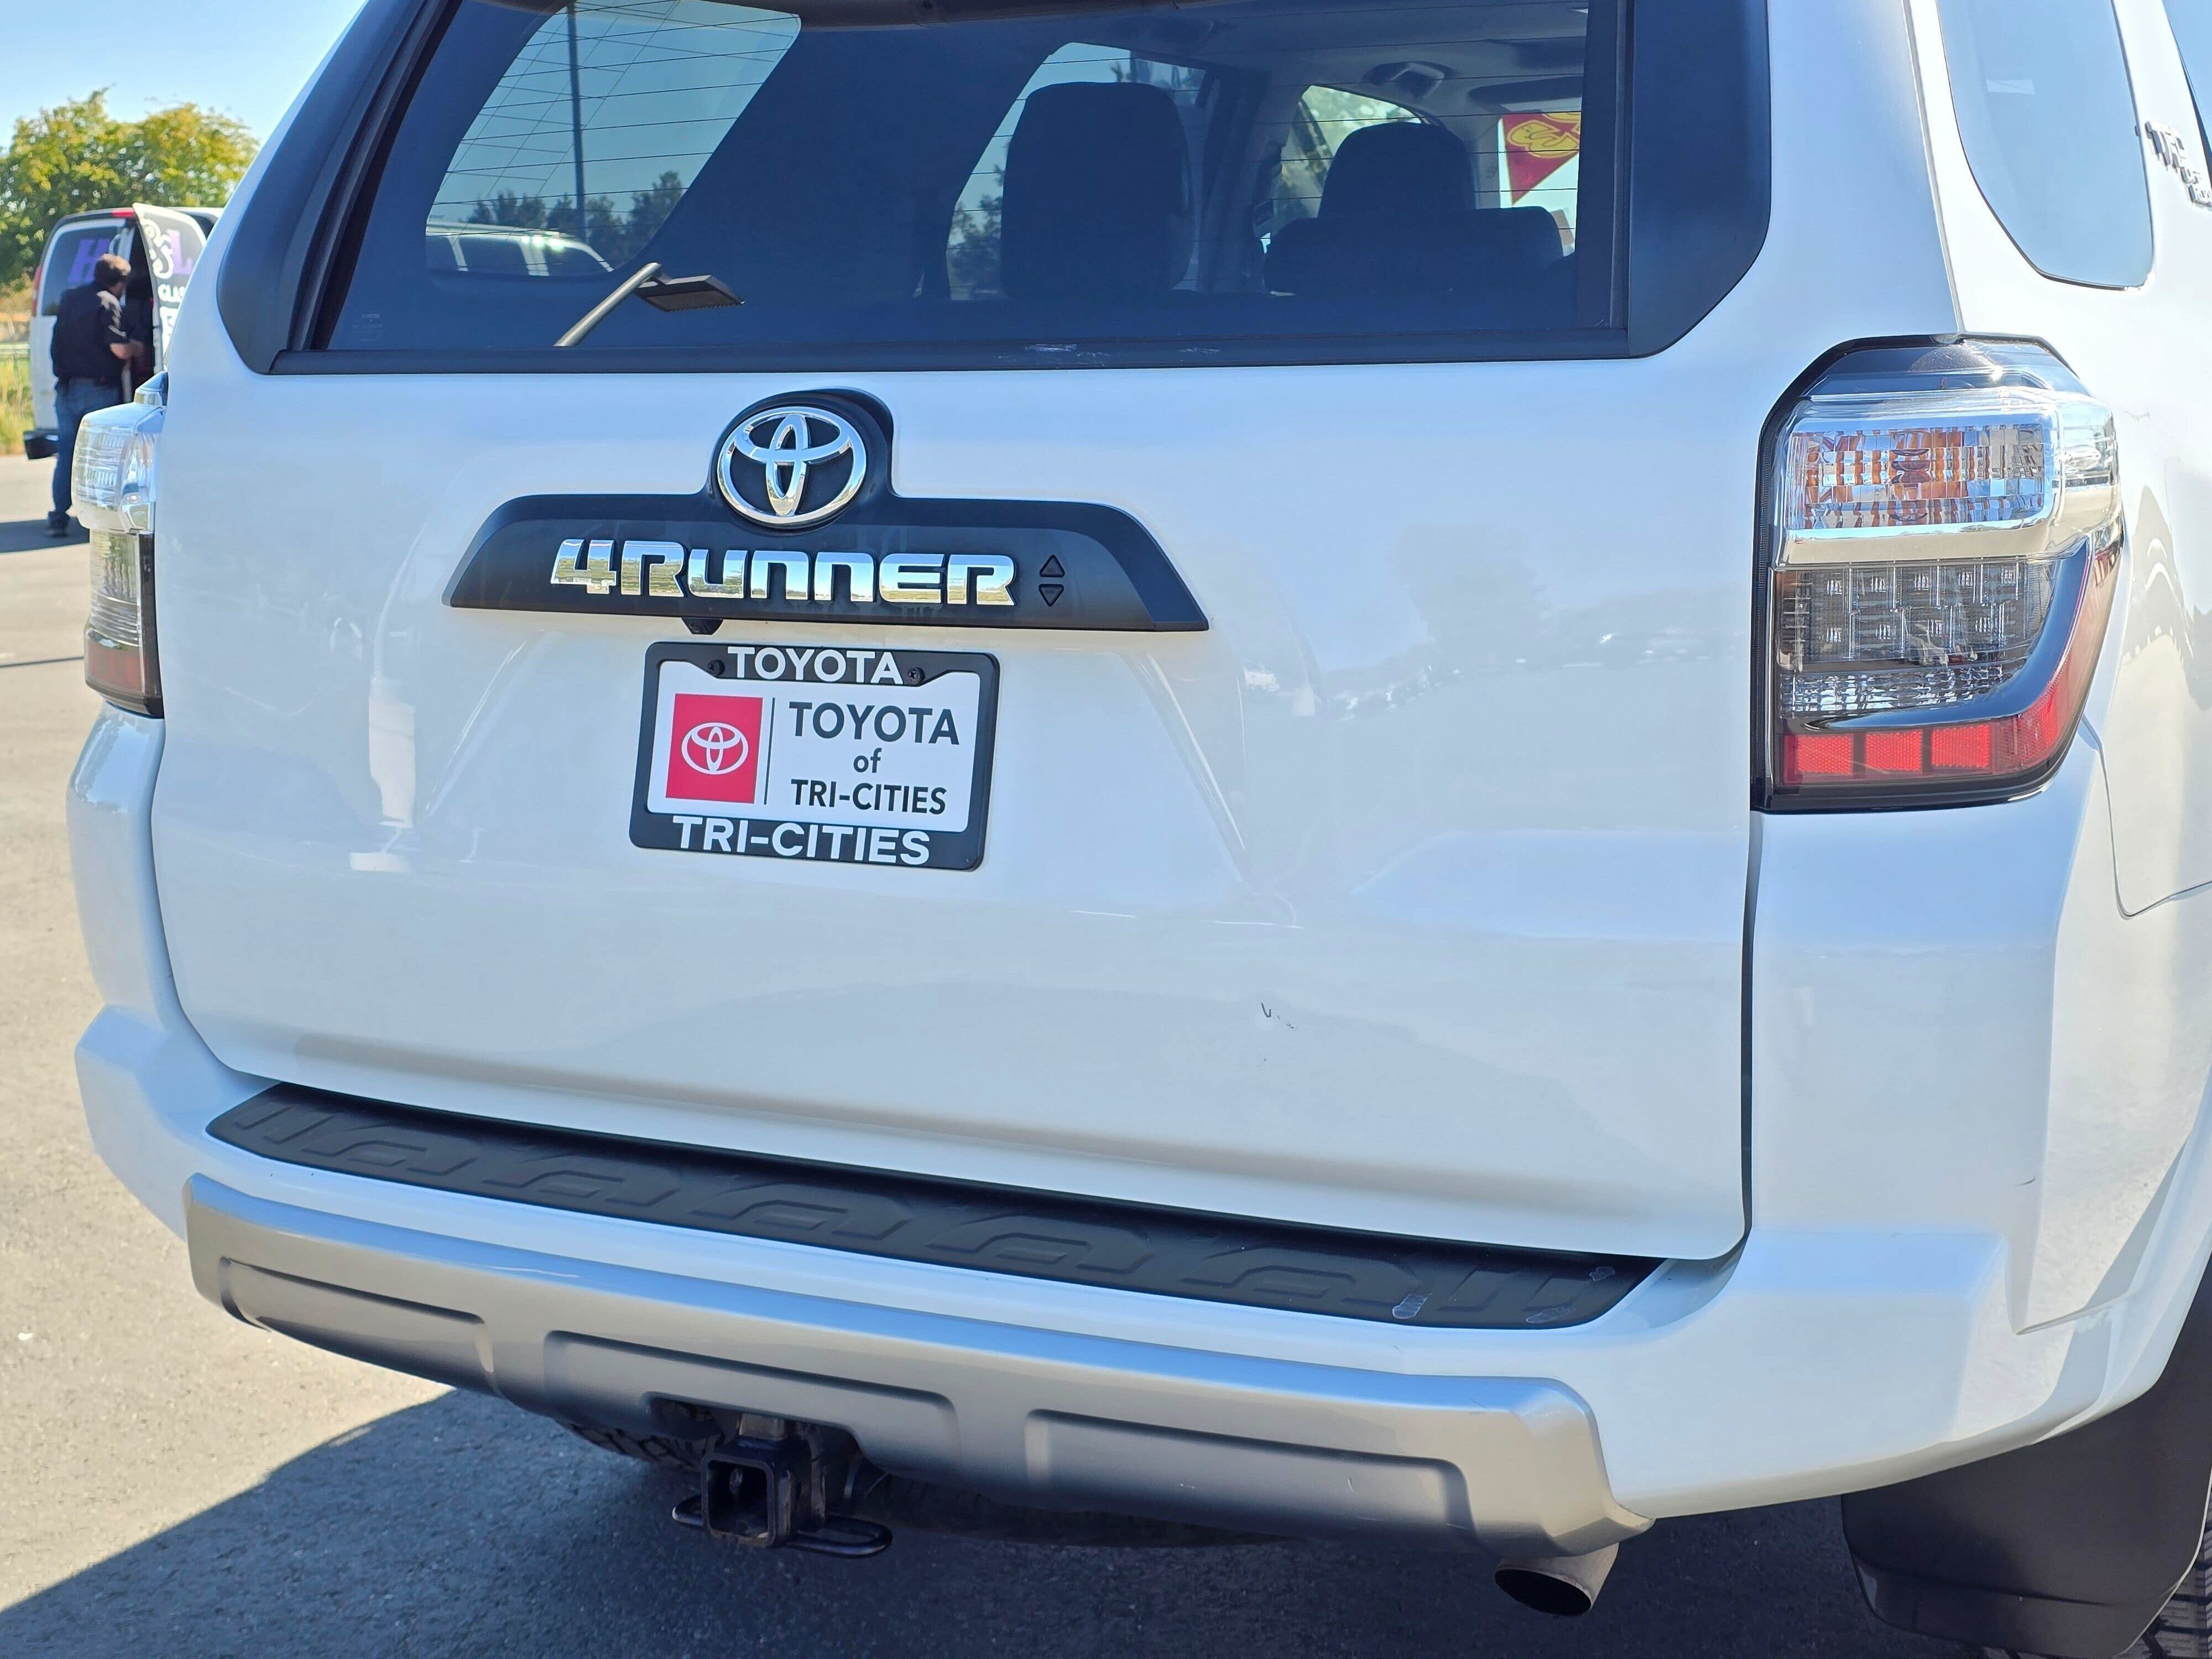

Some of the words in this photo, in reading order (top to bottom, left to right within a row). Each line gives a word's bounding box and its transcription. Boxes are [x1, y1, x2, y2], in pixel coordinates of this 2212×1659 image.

[551, 539, 1015, 606] 4RUNNER
[728, 646, 903, 685] TOYOTA
[789, 701, 959, 745] TOYOTA
[853, 748, 882, 773] of
[791, 779, 947, 815] TRI-CITIES
[673, 816, 930, 865] TRI-CITIES
